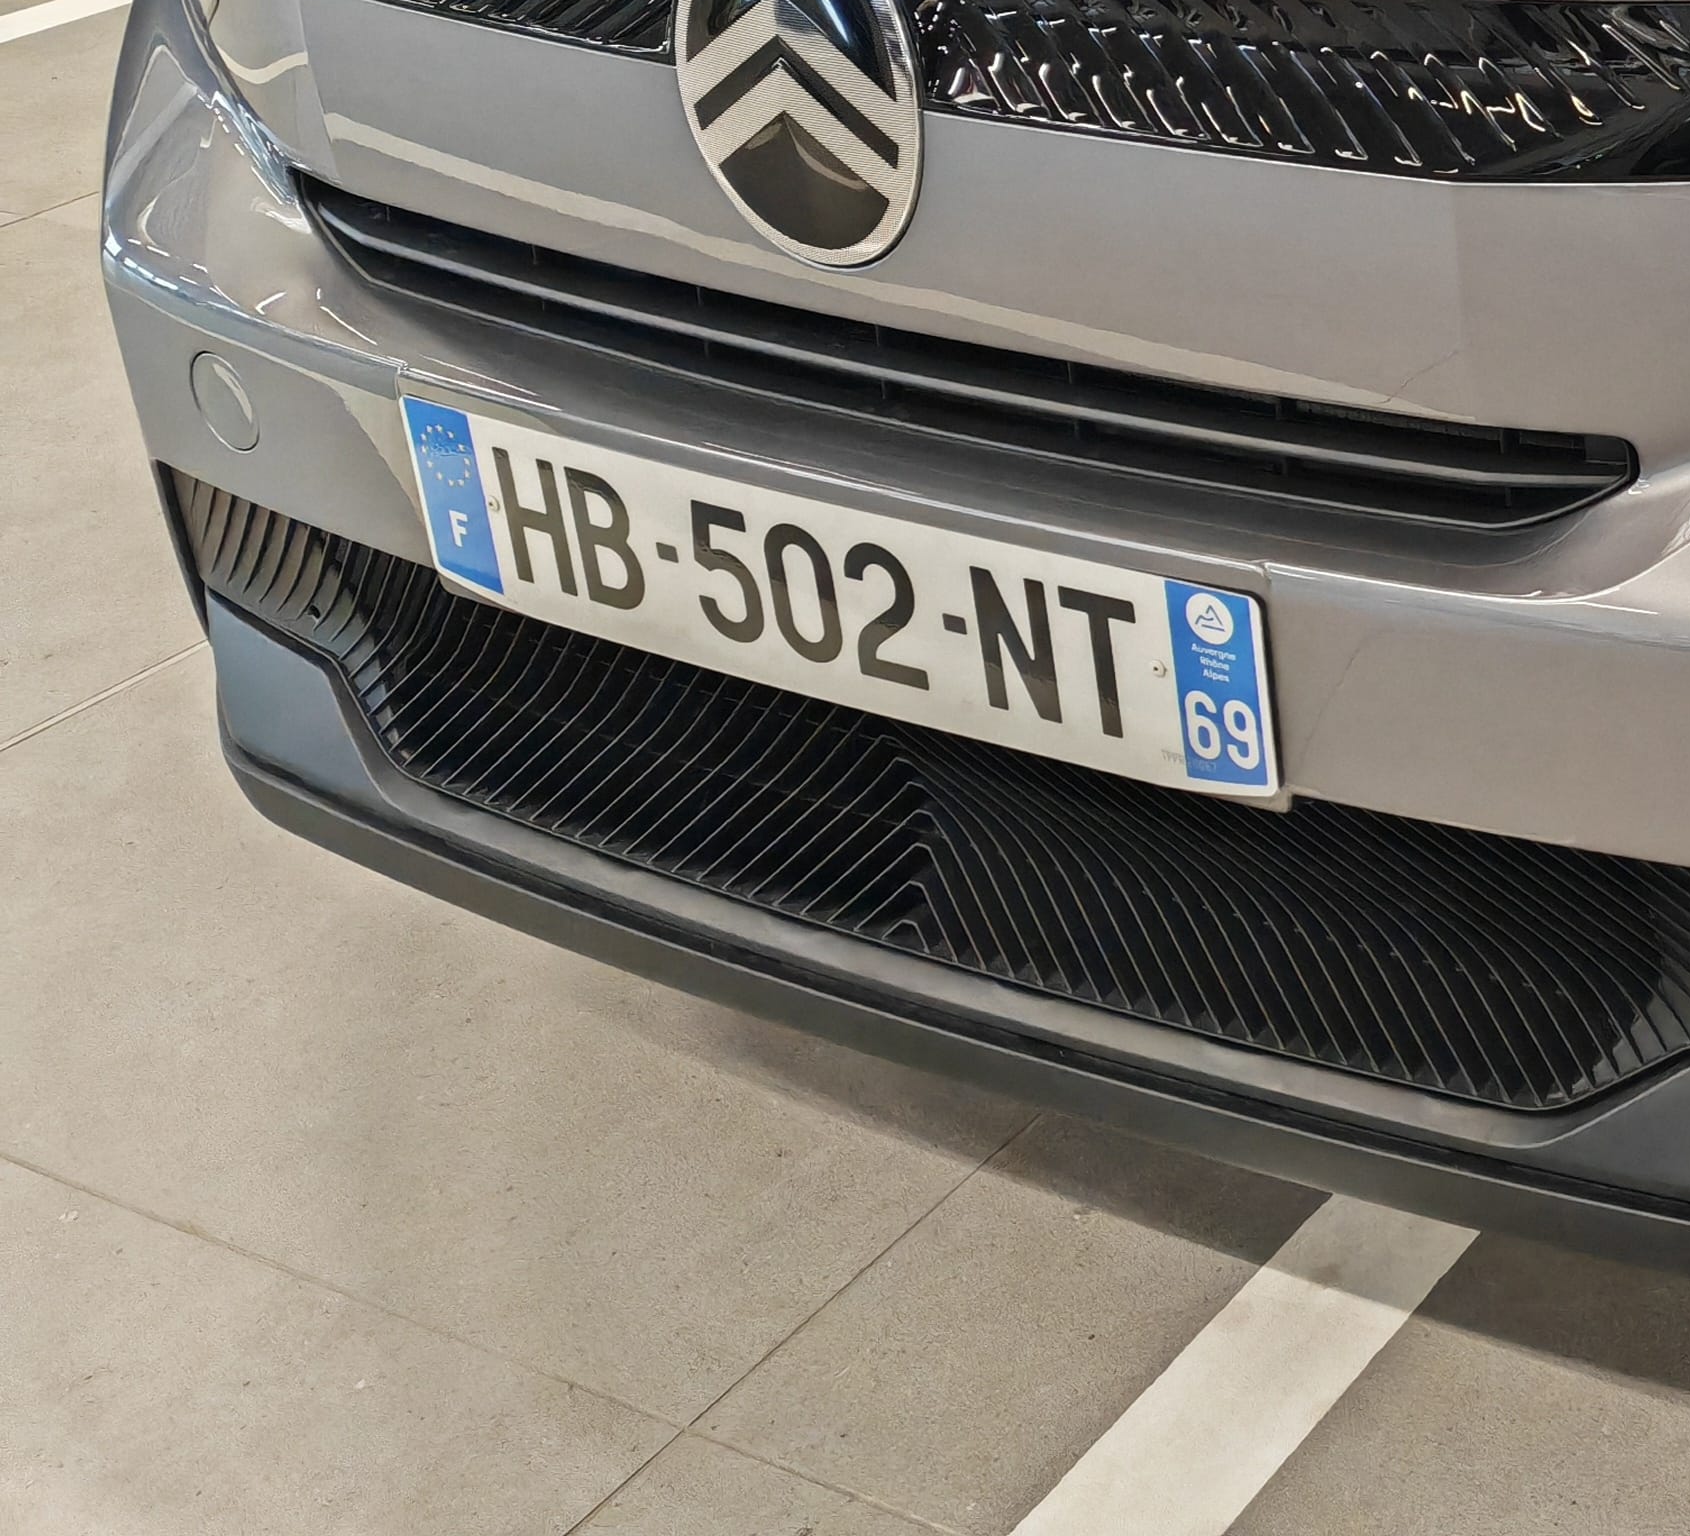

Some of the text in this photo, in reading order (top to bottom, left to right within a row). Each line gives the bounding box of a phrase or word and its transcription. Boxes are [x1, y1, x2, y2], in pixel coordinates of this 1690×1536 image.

[448, 509, 469, 548] F
[491, 446, 1136, 739] HB-502-NT
[1184, 690, 1260, 770] 69
